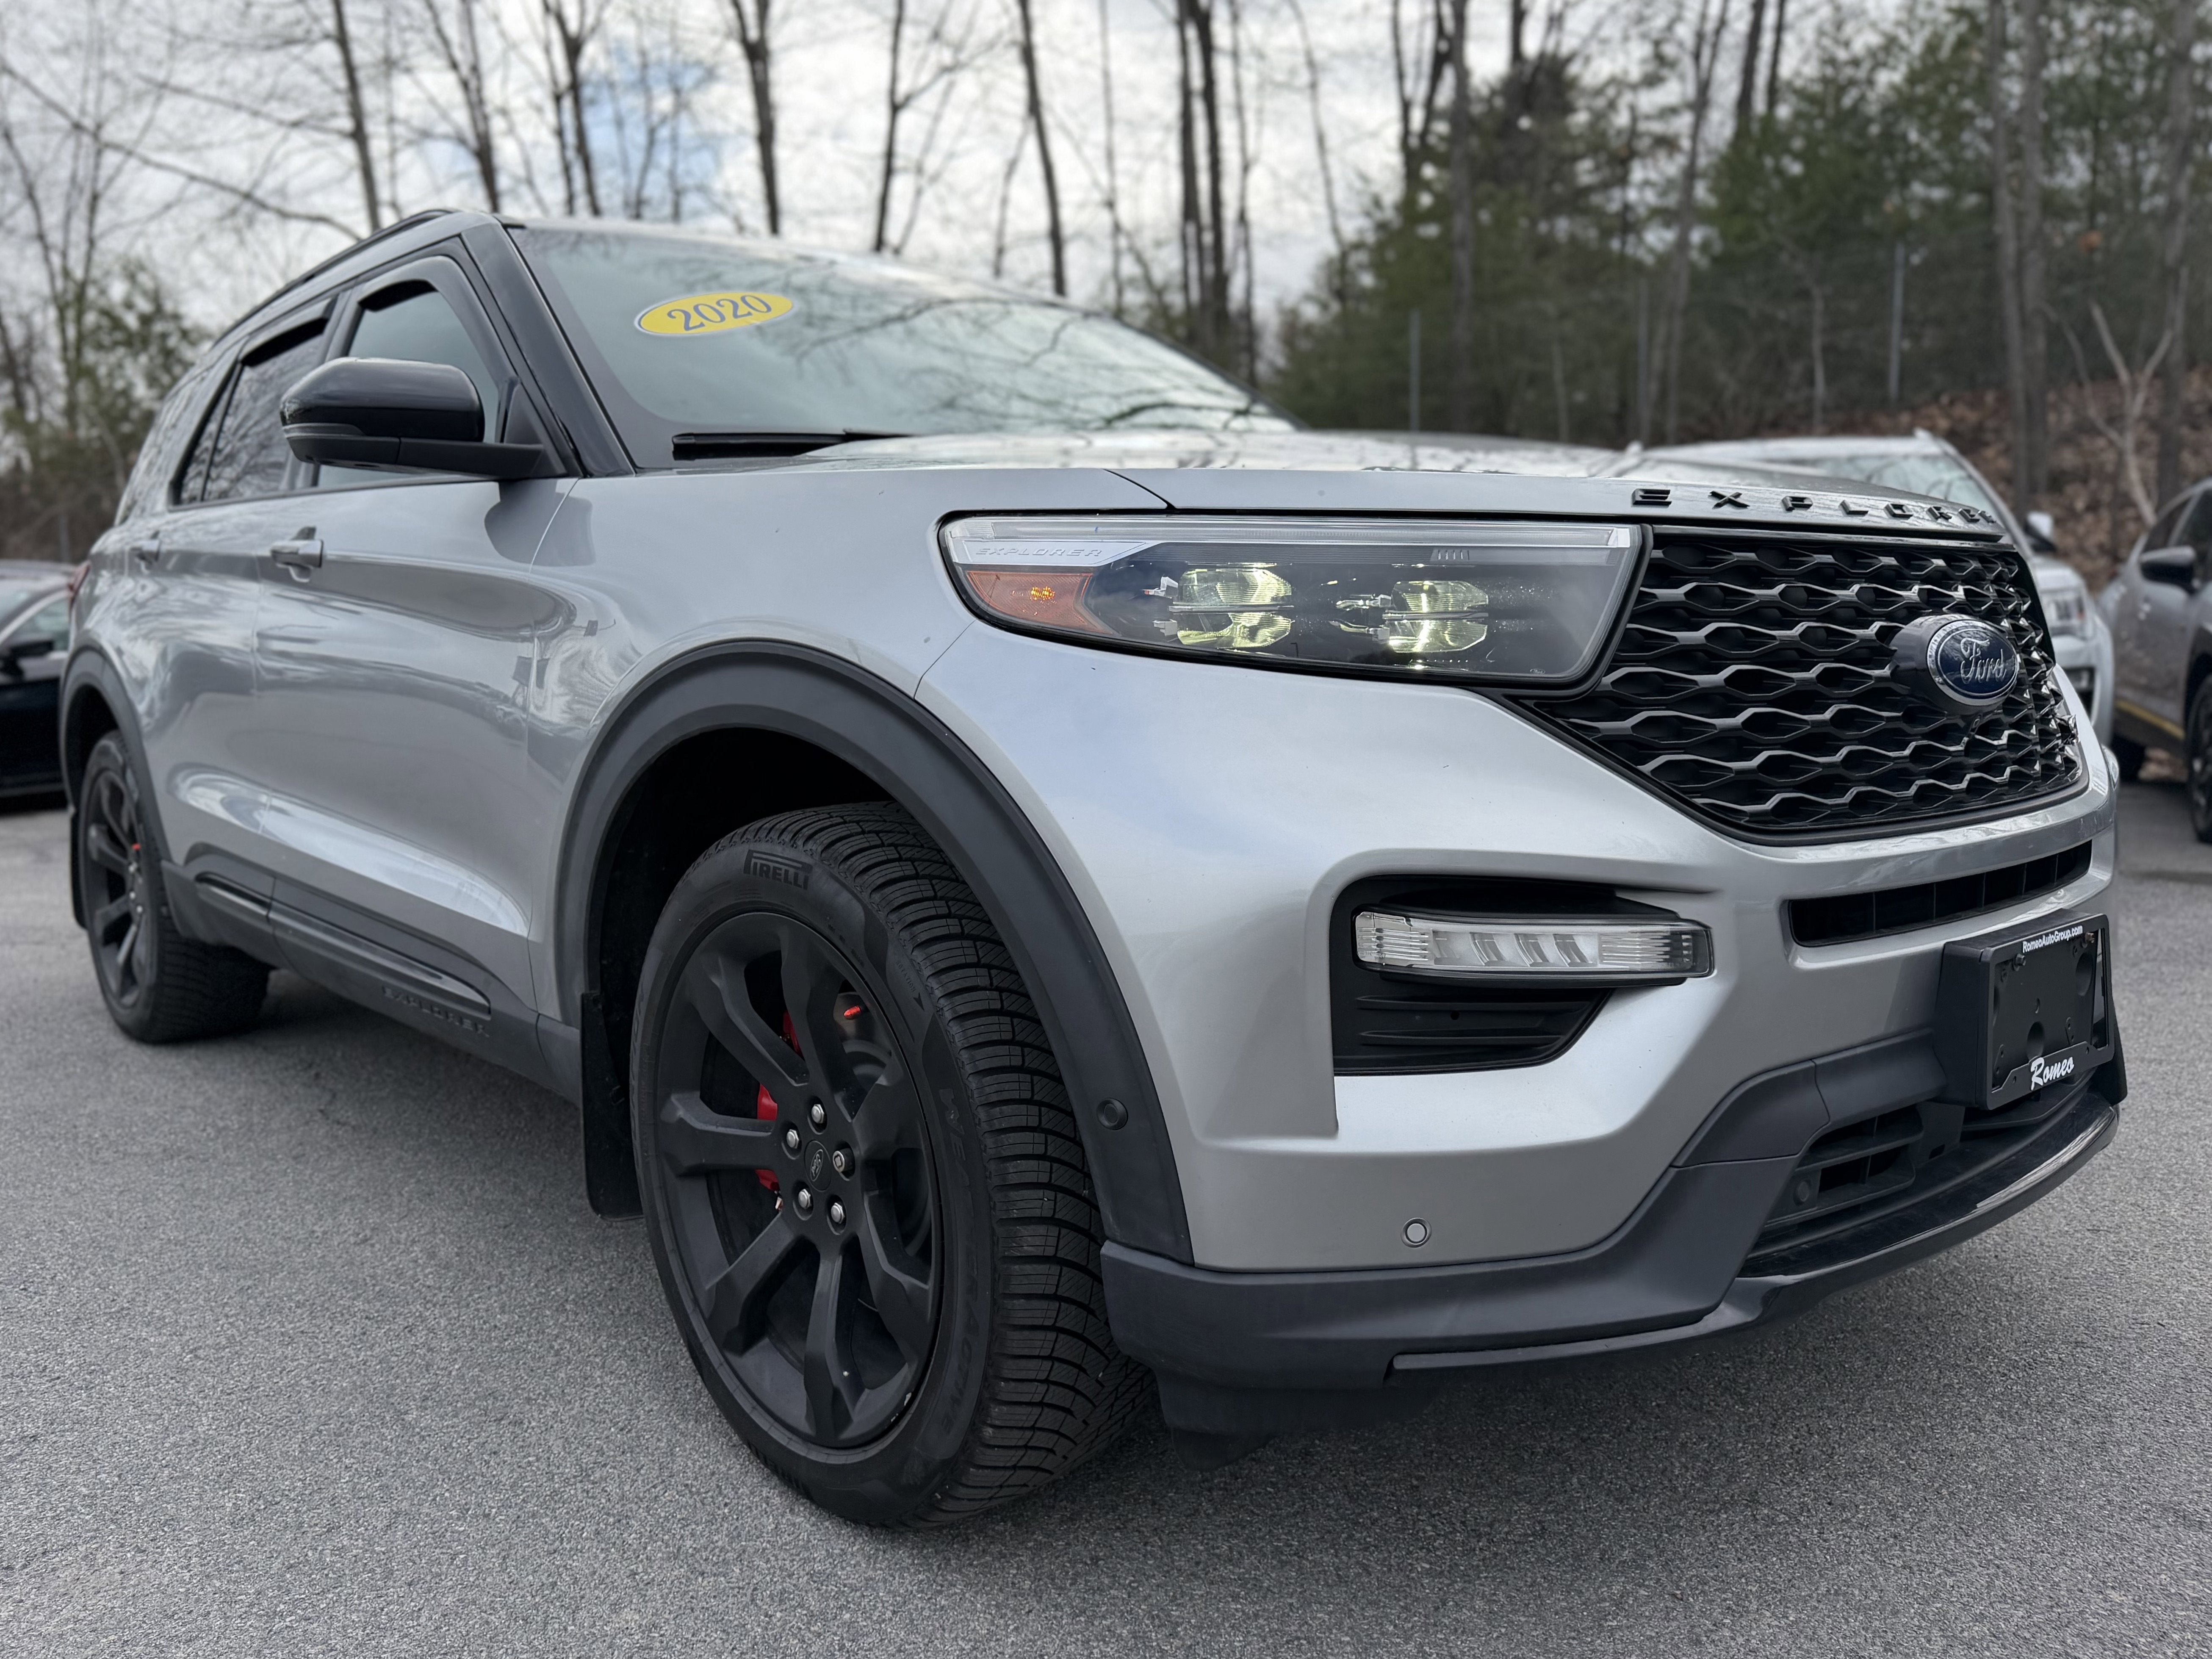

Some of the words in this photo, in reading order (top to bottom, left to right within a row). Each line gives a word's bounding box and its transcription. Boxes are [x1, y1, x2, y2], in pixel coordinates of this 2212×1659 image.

[667, 295, 772, 332] 2020
[1631, 488, 1996, 523] EXPLORER
[975, 548, 1102, 557] EXPLORER
[1960, 637, 2007, 684] Ford
[743, 849, 814, 890] PIRELLI
[2022, 925, 2083, 953] RomeoAutoGroup.com
[2030, 1056, 2075, 1091] Romeo
[939, 1088, 980, 1435] WEATERACTIVE
